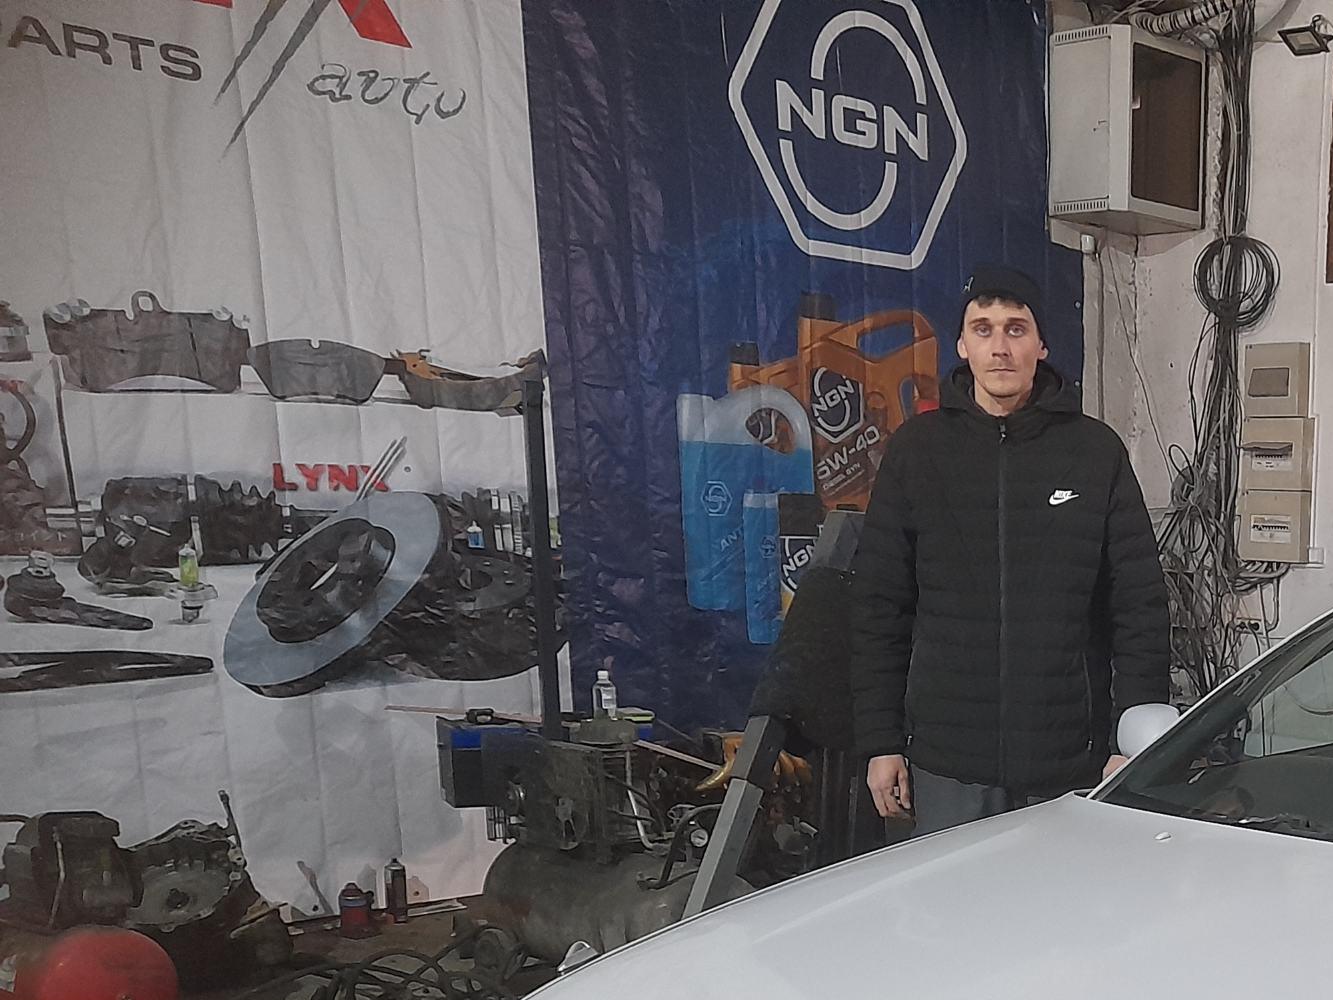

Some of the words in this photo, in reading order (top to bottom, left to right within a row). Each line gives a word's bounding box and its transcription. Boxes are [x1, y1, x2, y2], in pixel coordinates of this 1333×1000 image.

[8, 15, 202, 81] ARTS
[307, 63, 466, 124] auto
[776, 79, 928, 161] NGN
[811, 380, 855, 417] NGN
[272, 450, 398, 497] LYNX
[816, 425, 880, 480] 5W-40
